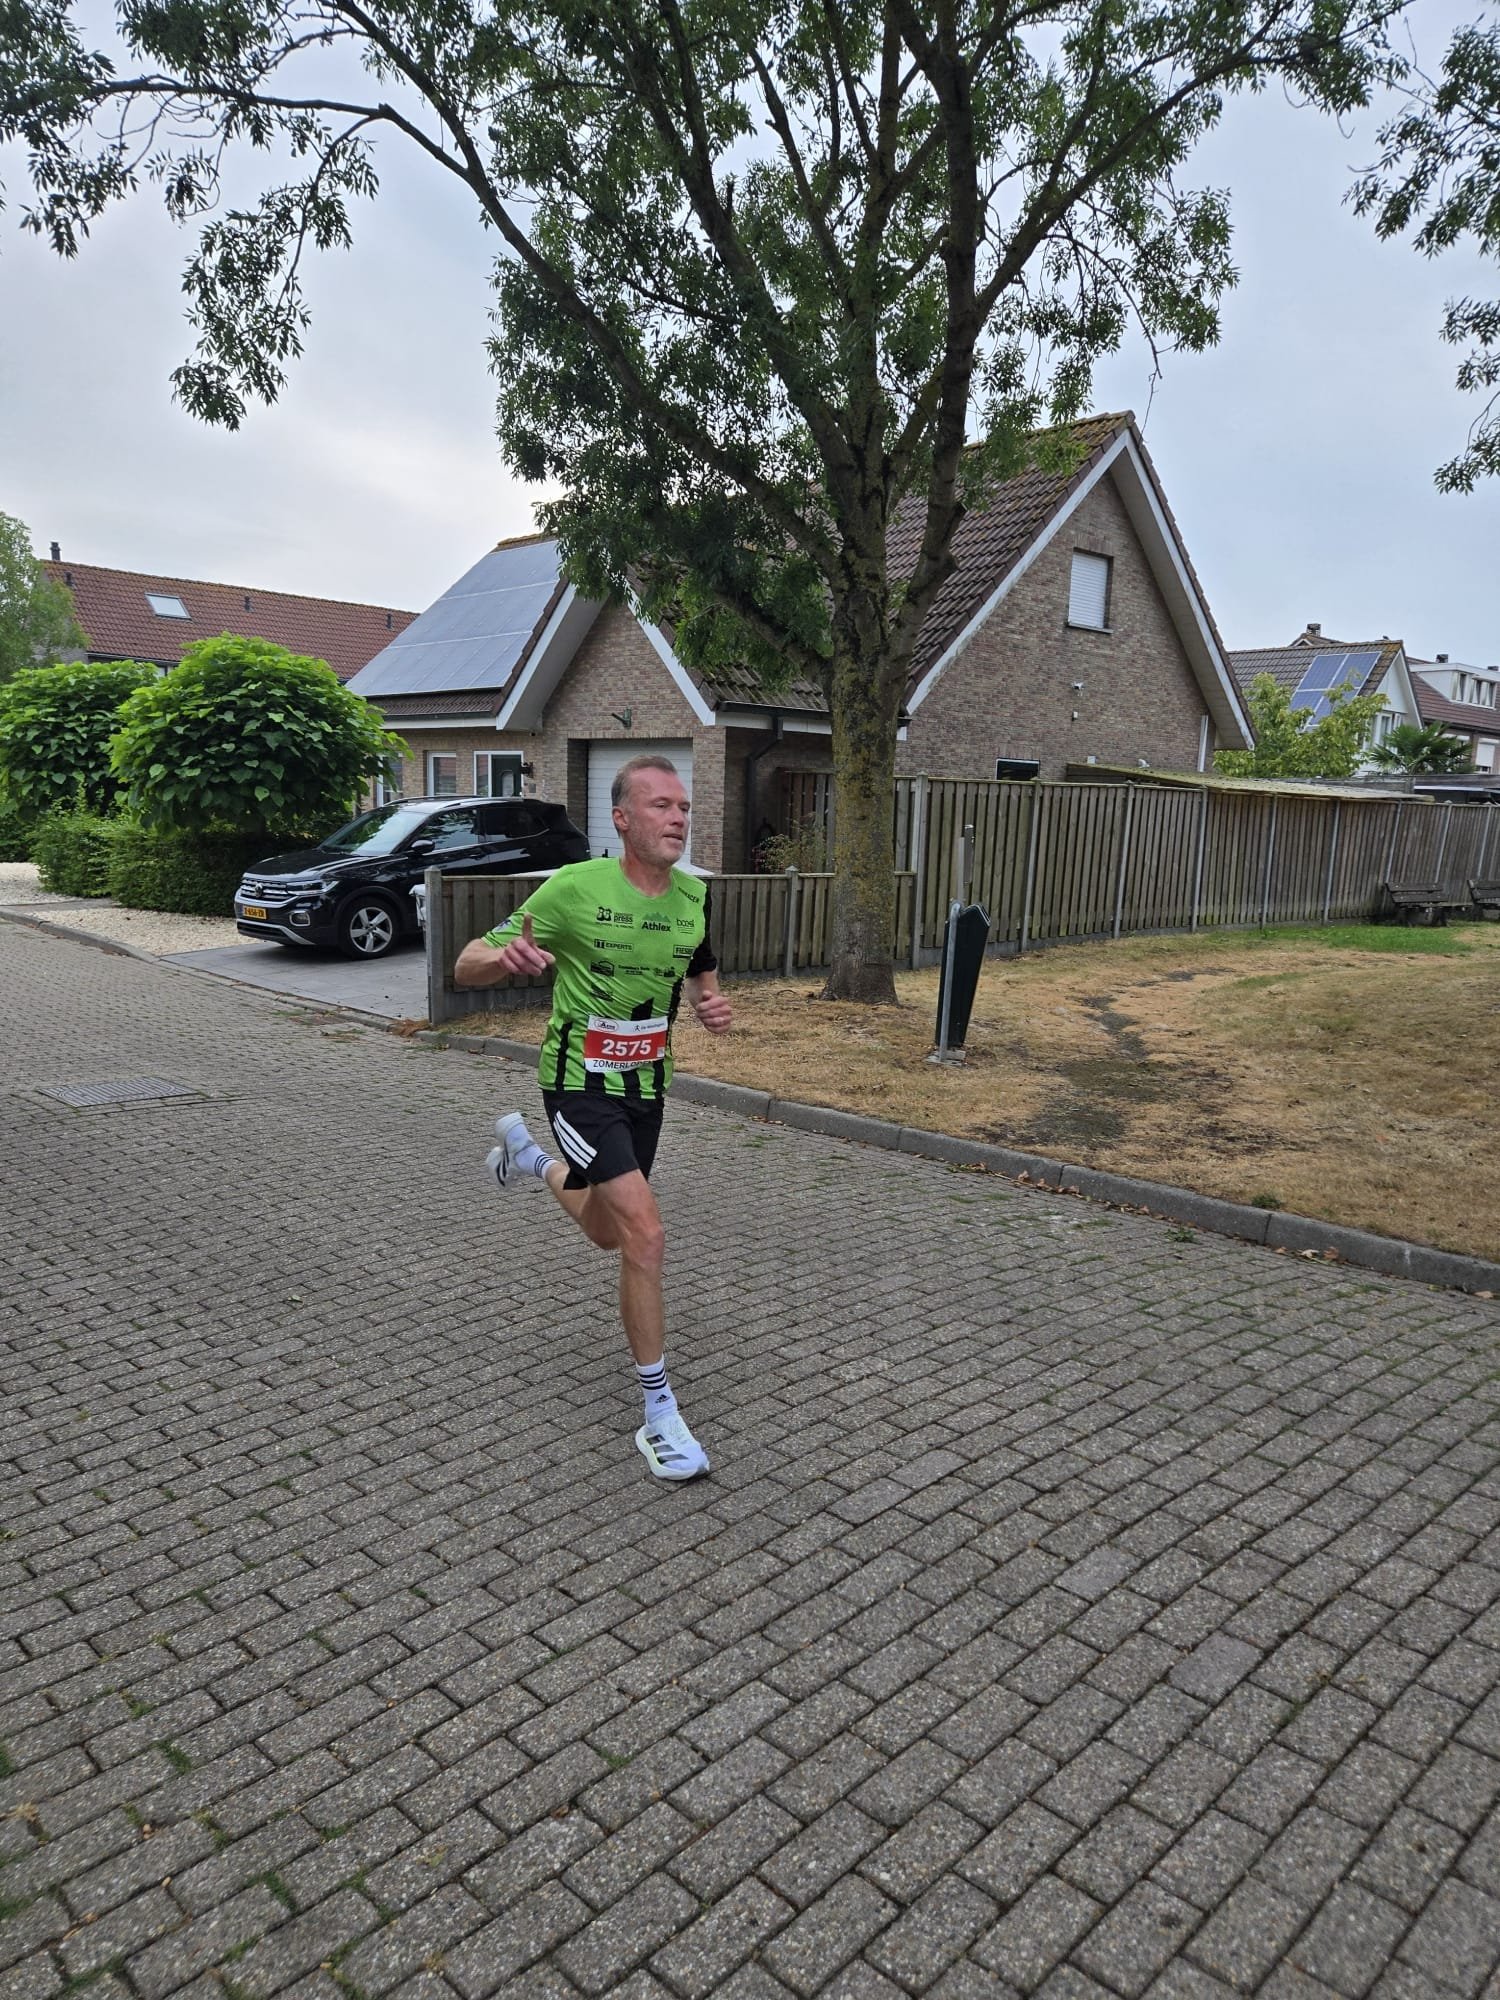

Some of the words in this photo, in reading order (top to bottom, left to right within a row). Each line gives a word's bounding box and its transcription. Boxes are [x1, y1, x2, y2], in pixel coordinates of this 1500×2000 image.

[613, 914, 633, 923] press
[641, 921, 671, 932] Athlex
[605, 942, 633, 951] EXPERTS
[601, 1038, 652, 1056] 2575
